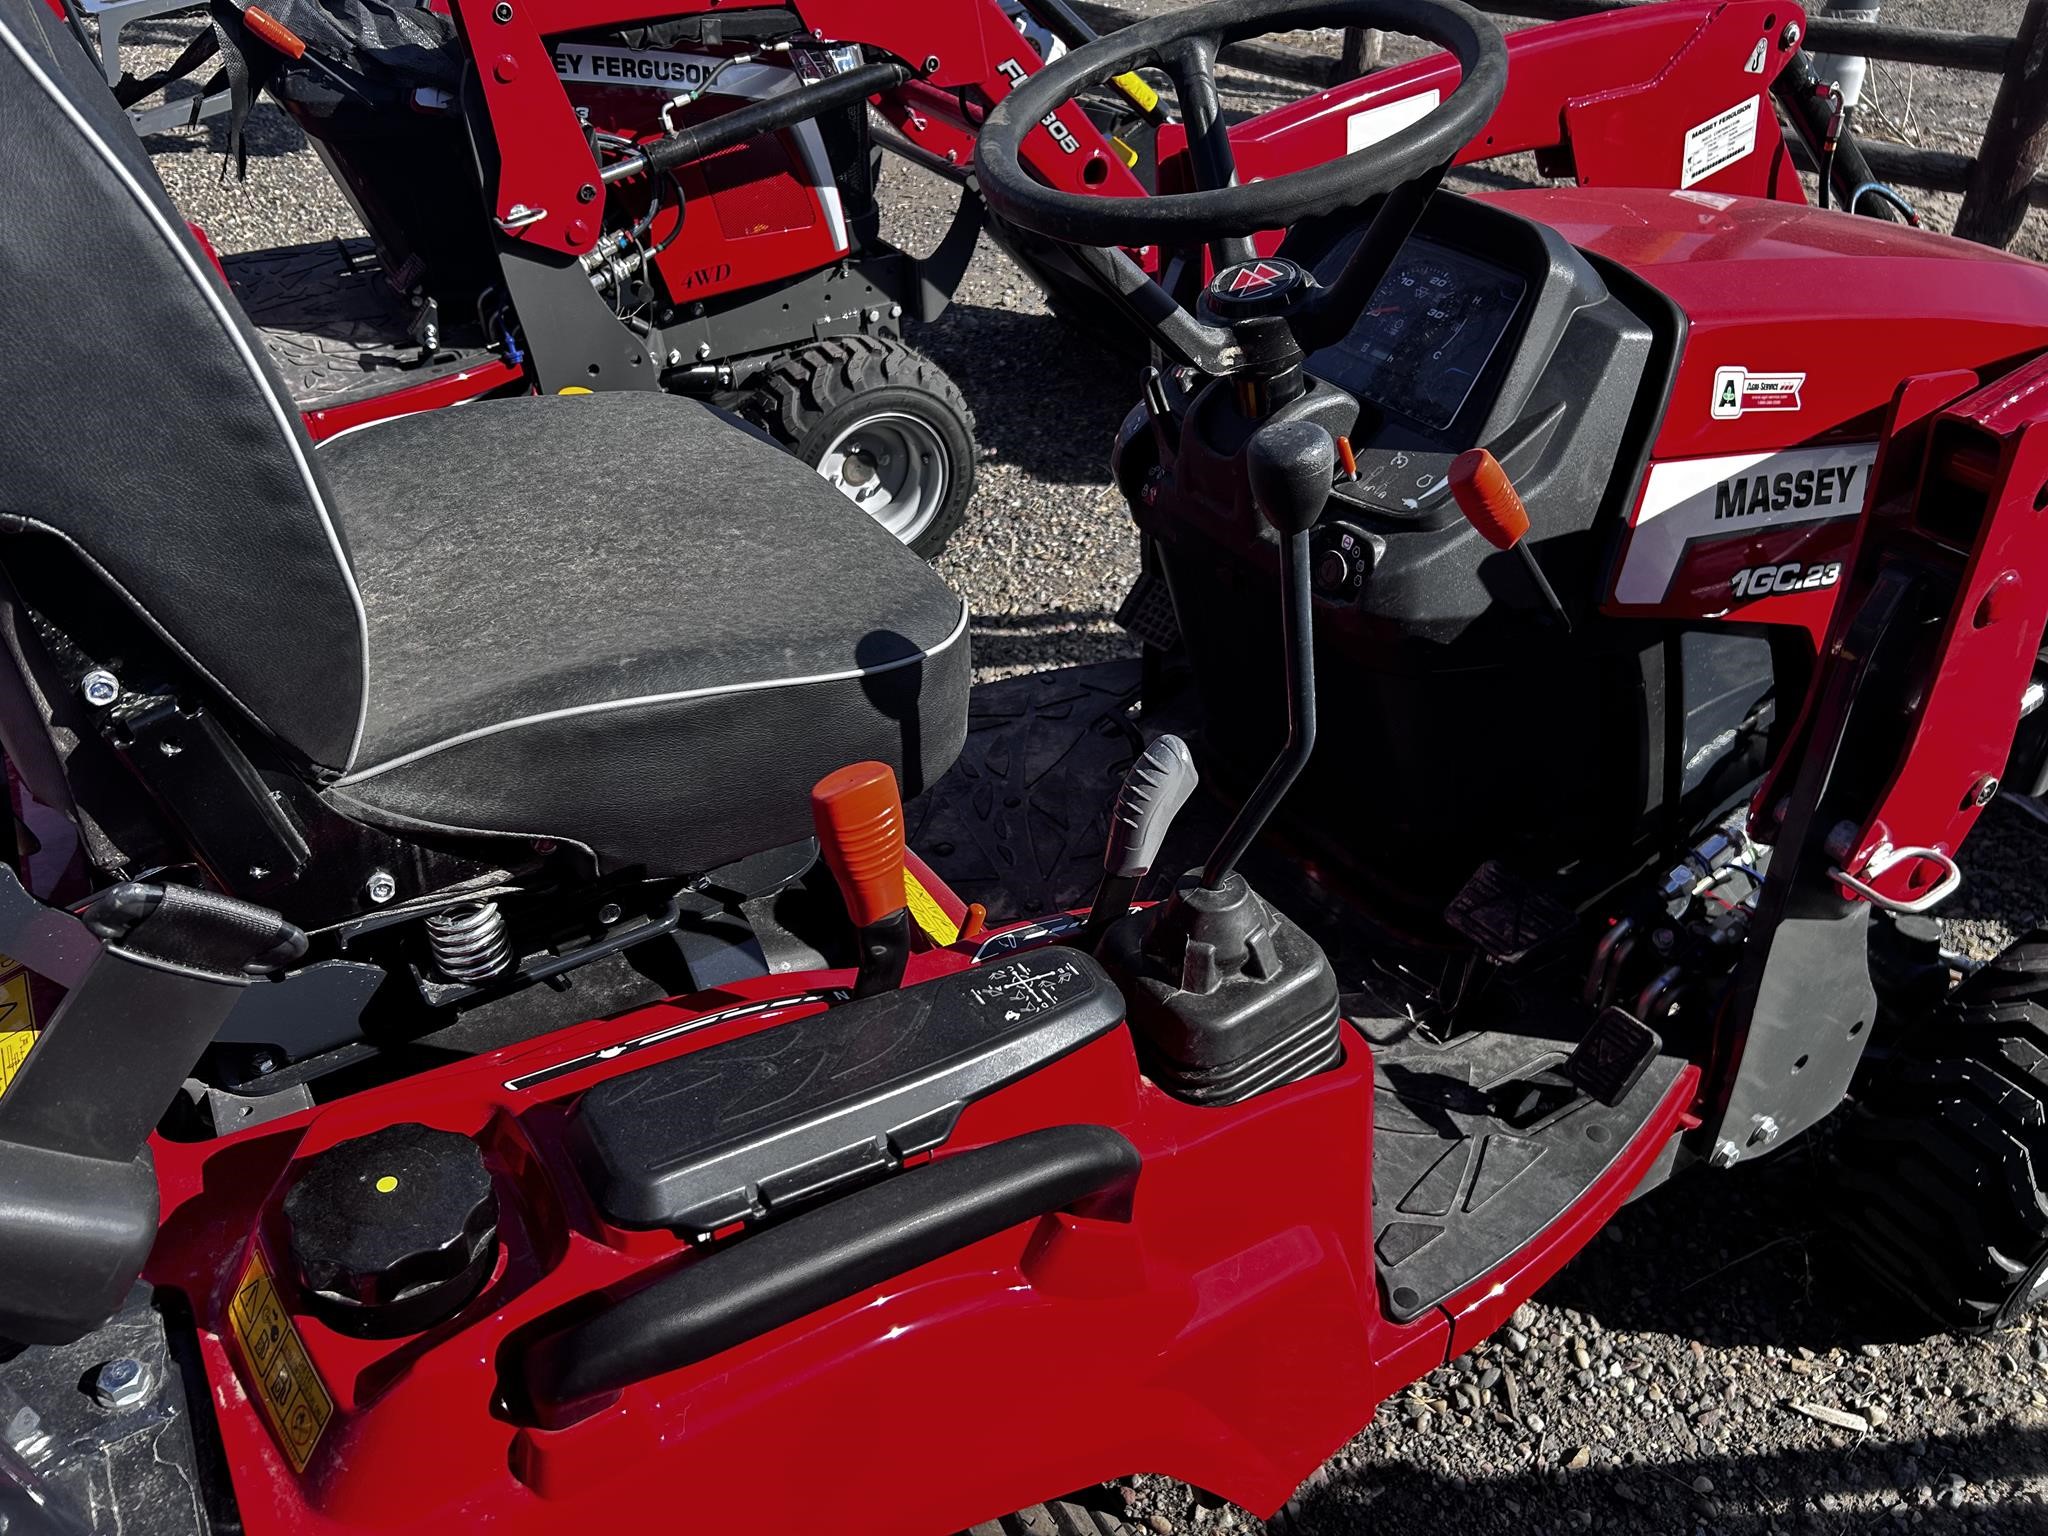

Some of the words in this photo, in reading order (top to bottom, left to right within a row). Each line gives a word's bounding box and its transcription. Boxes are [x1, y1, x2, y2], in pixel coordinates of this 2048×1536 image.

[1691, 121, 1718, 139] MASSEY
[1719, 103, 1752, 125] FERGUSON
[682, 264, 730, 289] 4WD
[1401, 277, 1415, 287] 10
[1430, 277, 1447, 287] 20
[1427, 308, 1445, 319] 30
[1714, 464, 1858, 520] MASSEY
[1731, 561, 1842, 597] 1GC.23
